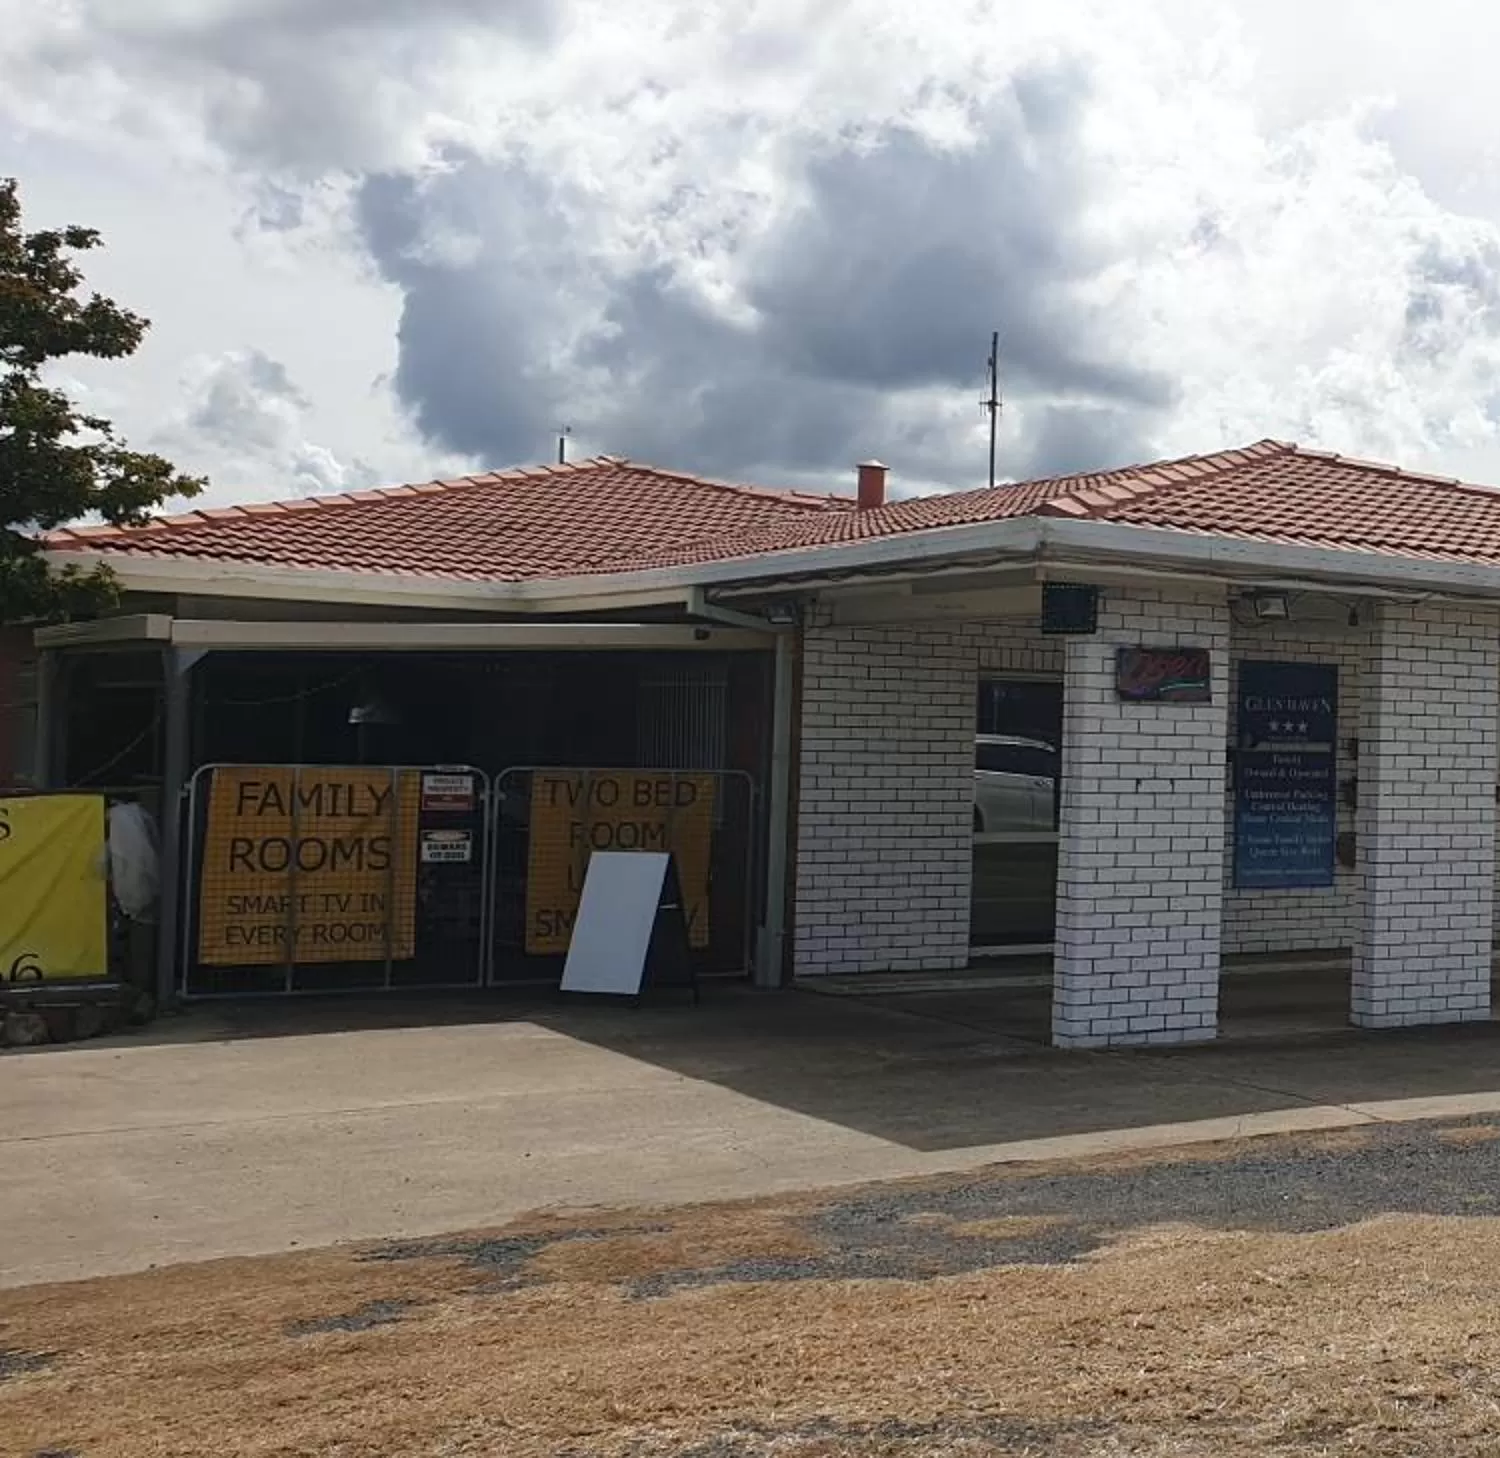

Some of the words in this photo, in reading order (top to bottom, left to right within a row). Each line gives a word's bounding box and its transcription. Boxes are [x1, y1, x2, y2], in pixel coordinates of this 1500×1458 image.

[236, 781, 393, 817] FAMILY
[543, 778, 621, 808] TWO
[633, 779, 698, 808] BED
[568, 821, 667, 850] ROOM
[228, 836, 393, 873] ROOMS
[226, 893, 313, 915] SMART
[321, 892, 354, 913] TV
[360, 892, 386, 913] IN
[225, 925, 300, 946] EVERY
[312, 922, 387, 944] ROOM
